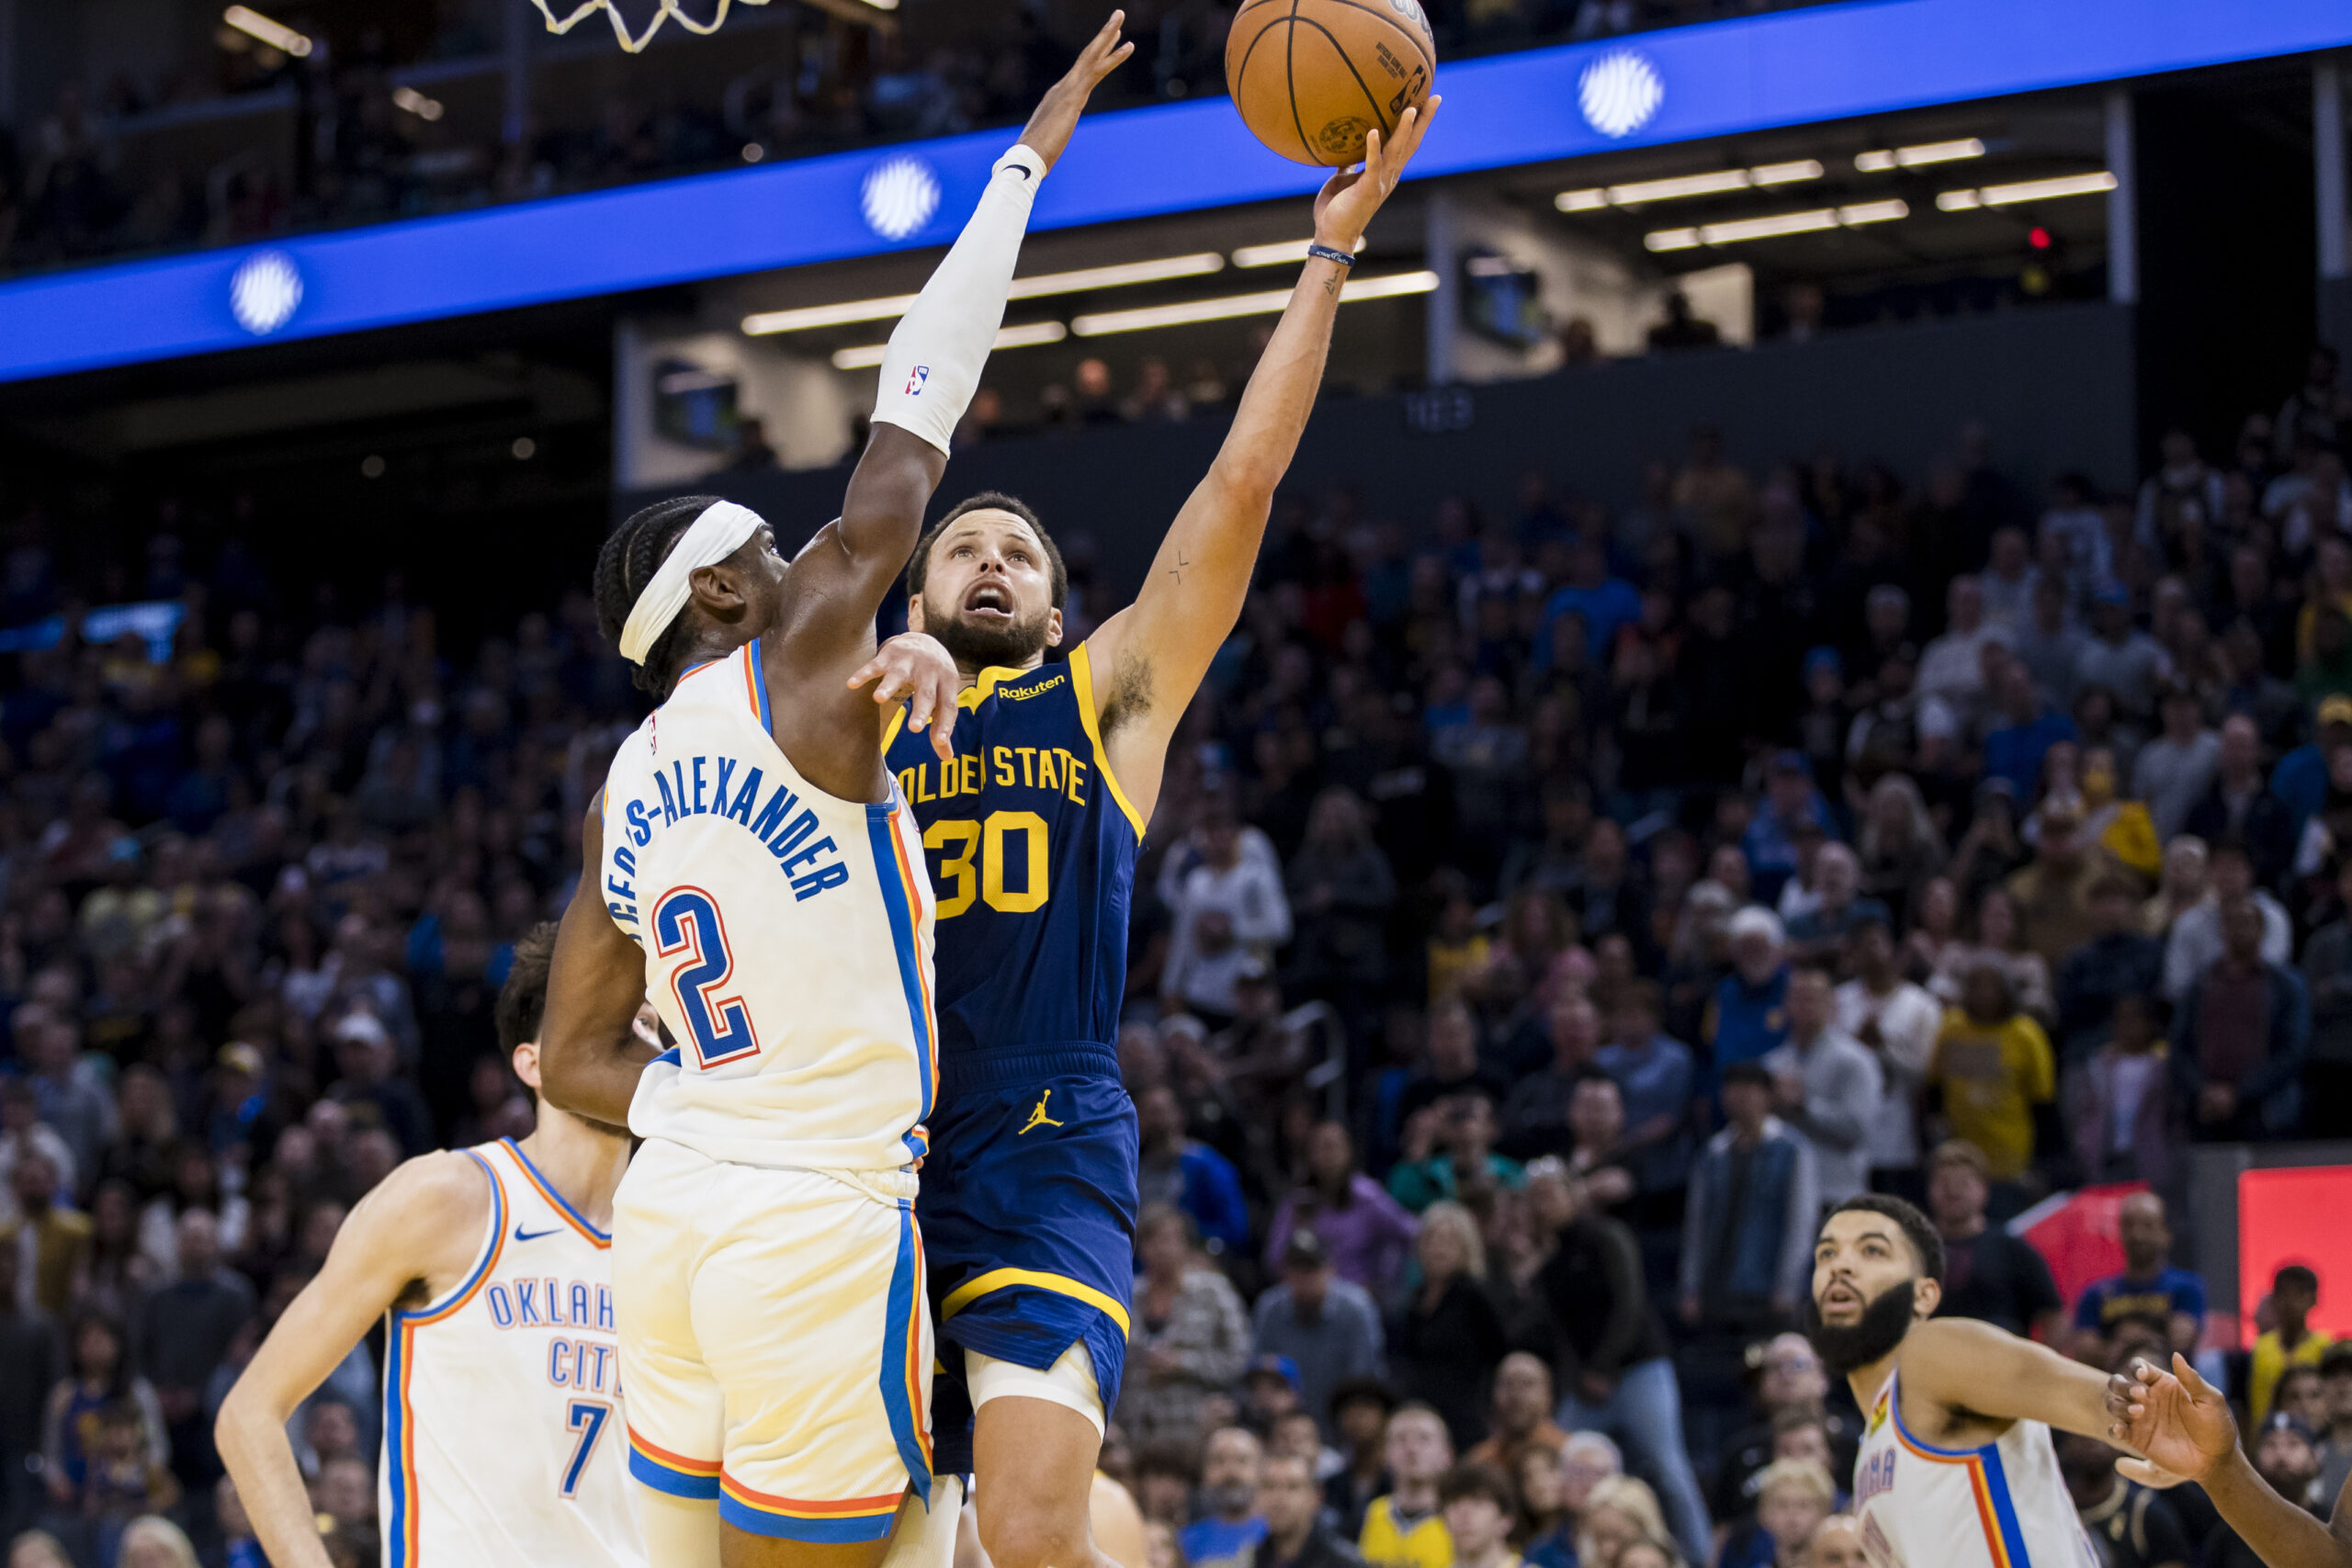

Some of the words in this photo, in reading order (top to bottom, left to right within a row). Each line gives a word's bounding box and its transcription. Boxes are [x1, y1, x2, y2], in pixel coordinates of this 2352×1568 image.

[999, 674, 1065, 700] Rakuten
[993, 746, 1087, 807] STATE
[923, 810, 1049, 919] 30
[651, 885, 761, 1070] 2
[548, 1337, 625, 1398] CIT
[559, 1398, 614, 1499] 7
